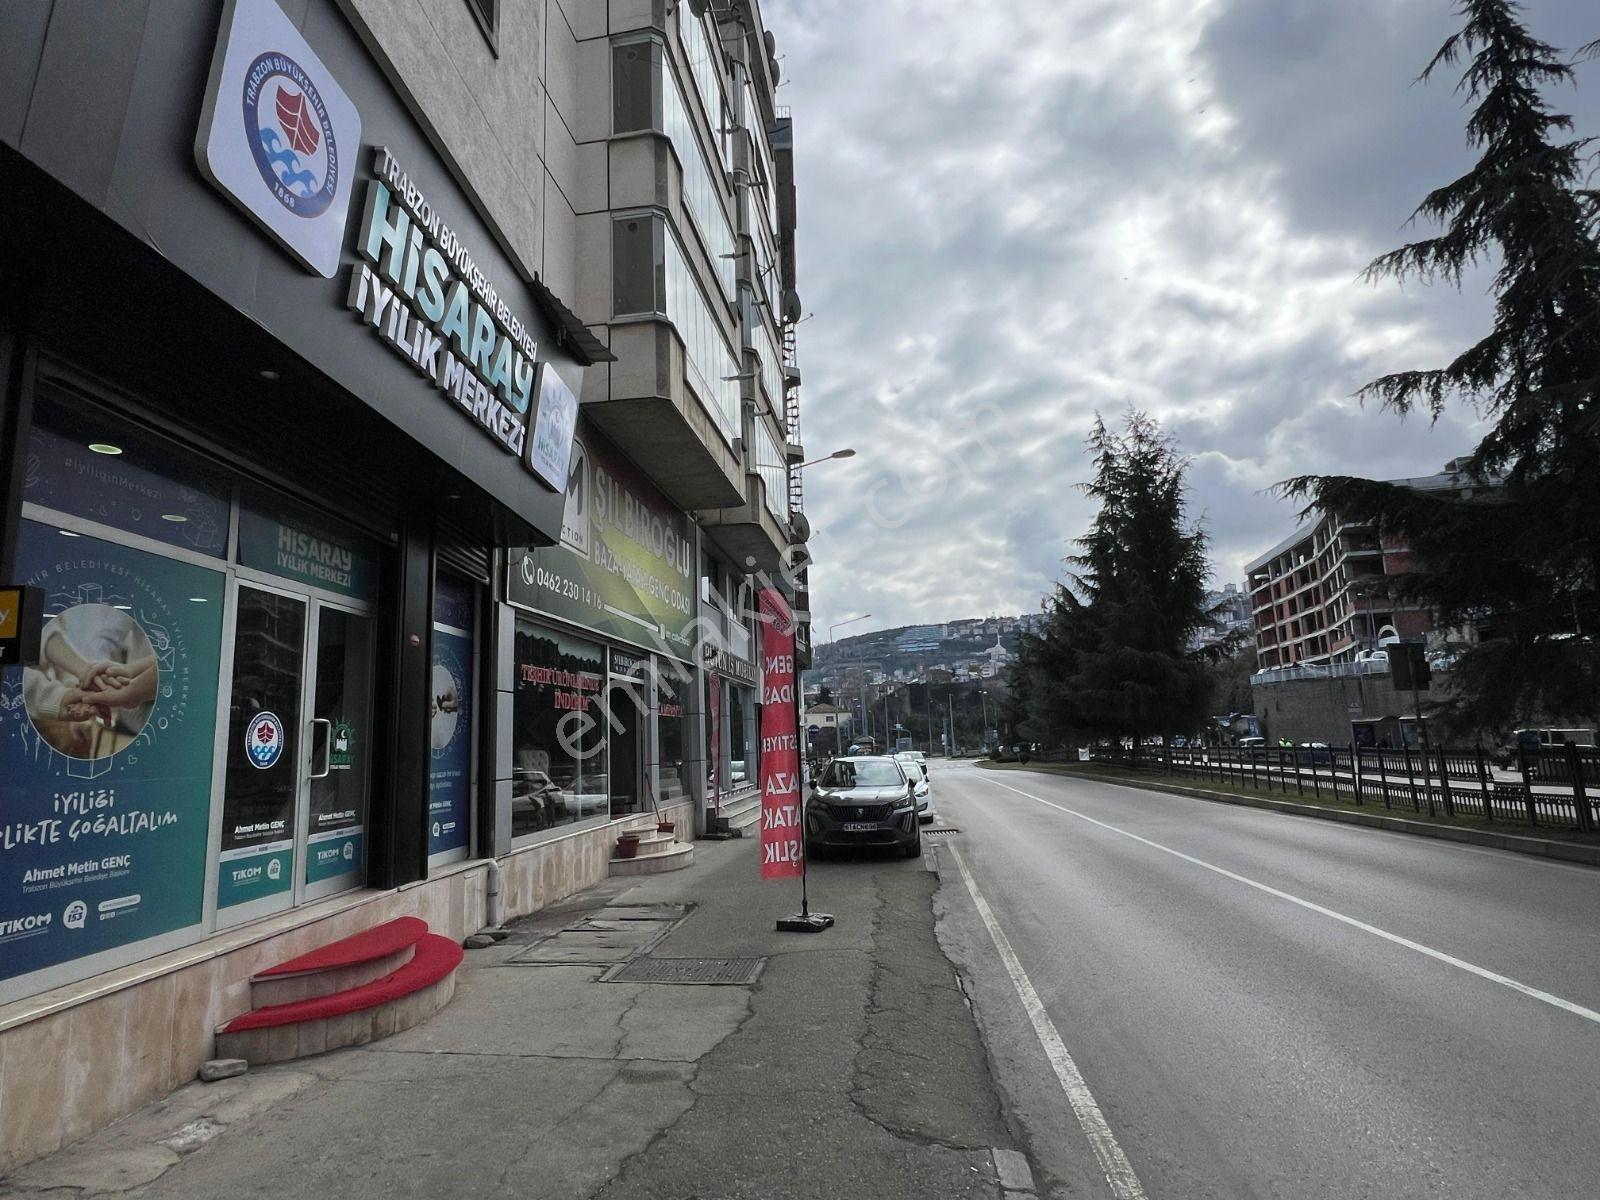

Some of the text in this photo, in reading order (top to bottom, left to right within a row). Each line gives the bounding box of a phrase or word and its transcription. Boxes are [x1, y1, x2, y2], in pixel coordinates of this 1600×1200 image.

[247, 58, 273, 106] TRABZON
[274, 182, 296, 208] 1868
[383, 146, 538, 362] TRABZON BÜYÜKŞEHİR BELEDİYESİ
[366, 181, 534, 414] HİSARAY
[356, 264, 526, 457] İYİLİK MERKEZİ
[537, 567, 560, 593] 0462
[563, 579, 579, 600] 230
[582, 587, 591, 606] 14
[54, 789, 115, 815] İYİLİĞİ
[0, 811, 178, 850] LİKTE ÇOĞALTALIM
[23, 855, 131, 883] Ahmet Metin GENÇ
[232, 866, 262, 881] TİKOM
[67, 911, 83, 923] 153
